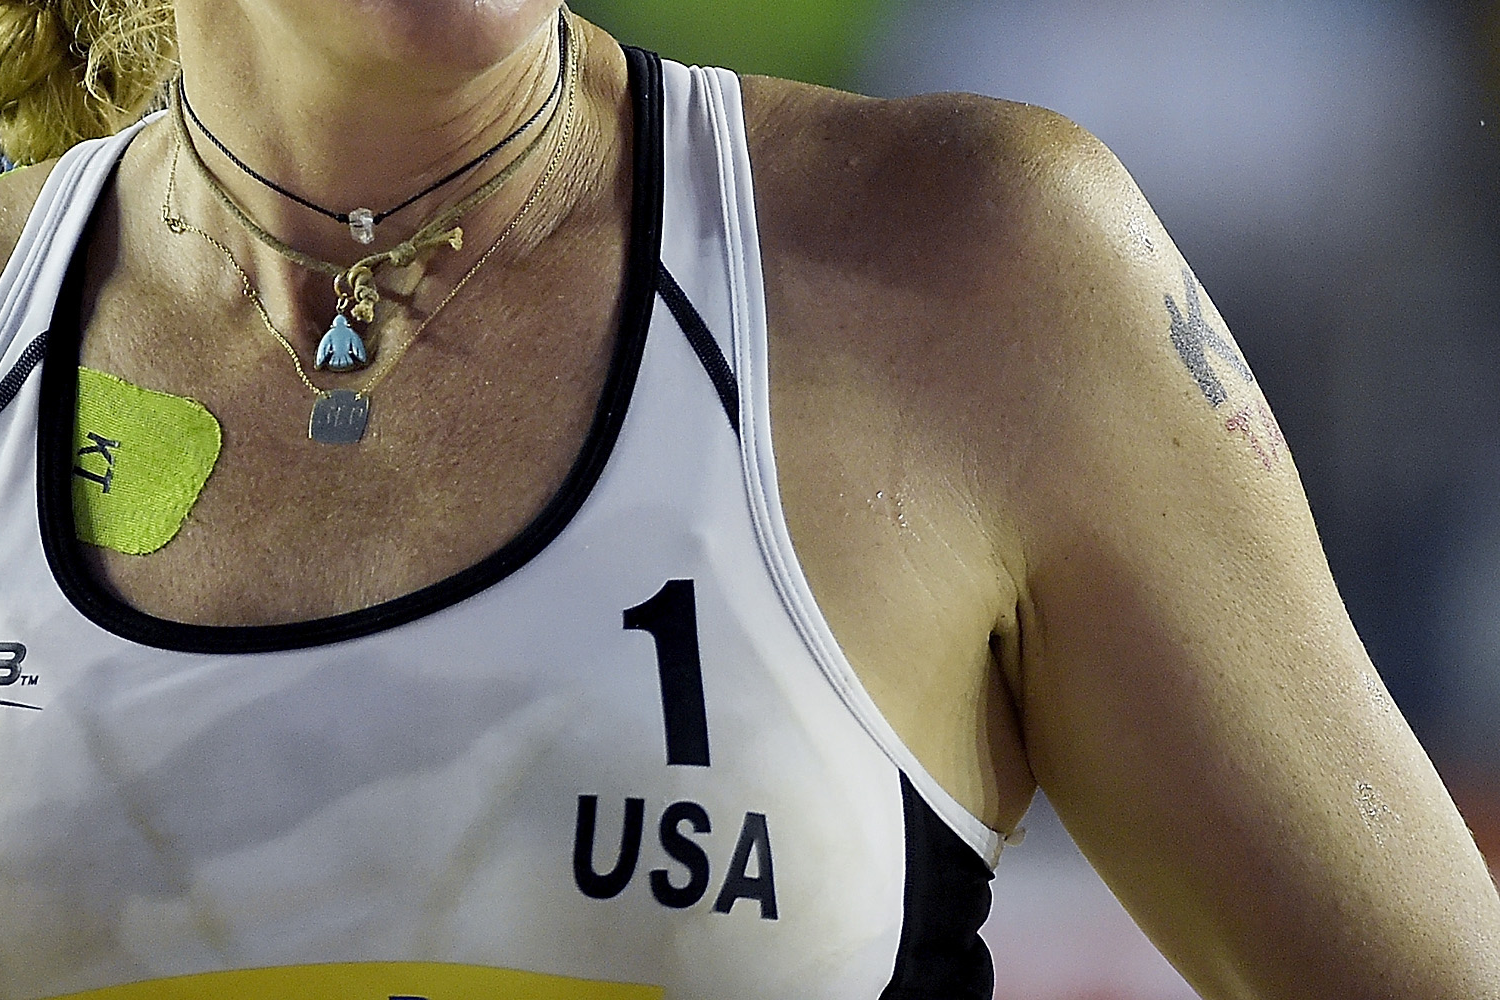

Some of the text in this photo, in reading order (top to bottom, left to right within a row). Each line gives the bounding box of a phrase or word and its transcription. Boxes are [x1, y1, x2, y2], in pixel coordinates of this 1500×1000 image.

[73, 431, 121, 494] KT
[622, 578, 711, 767] 1
[573, 794, 779, 921] USA
